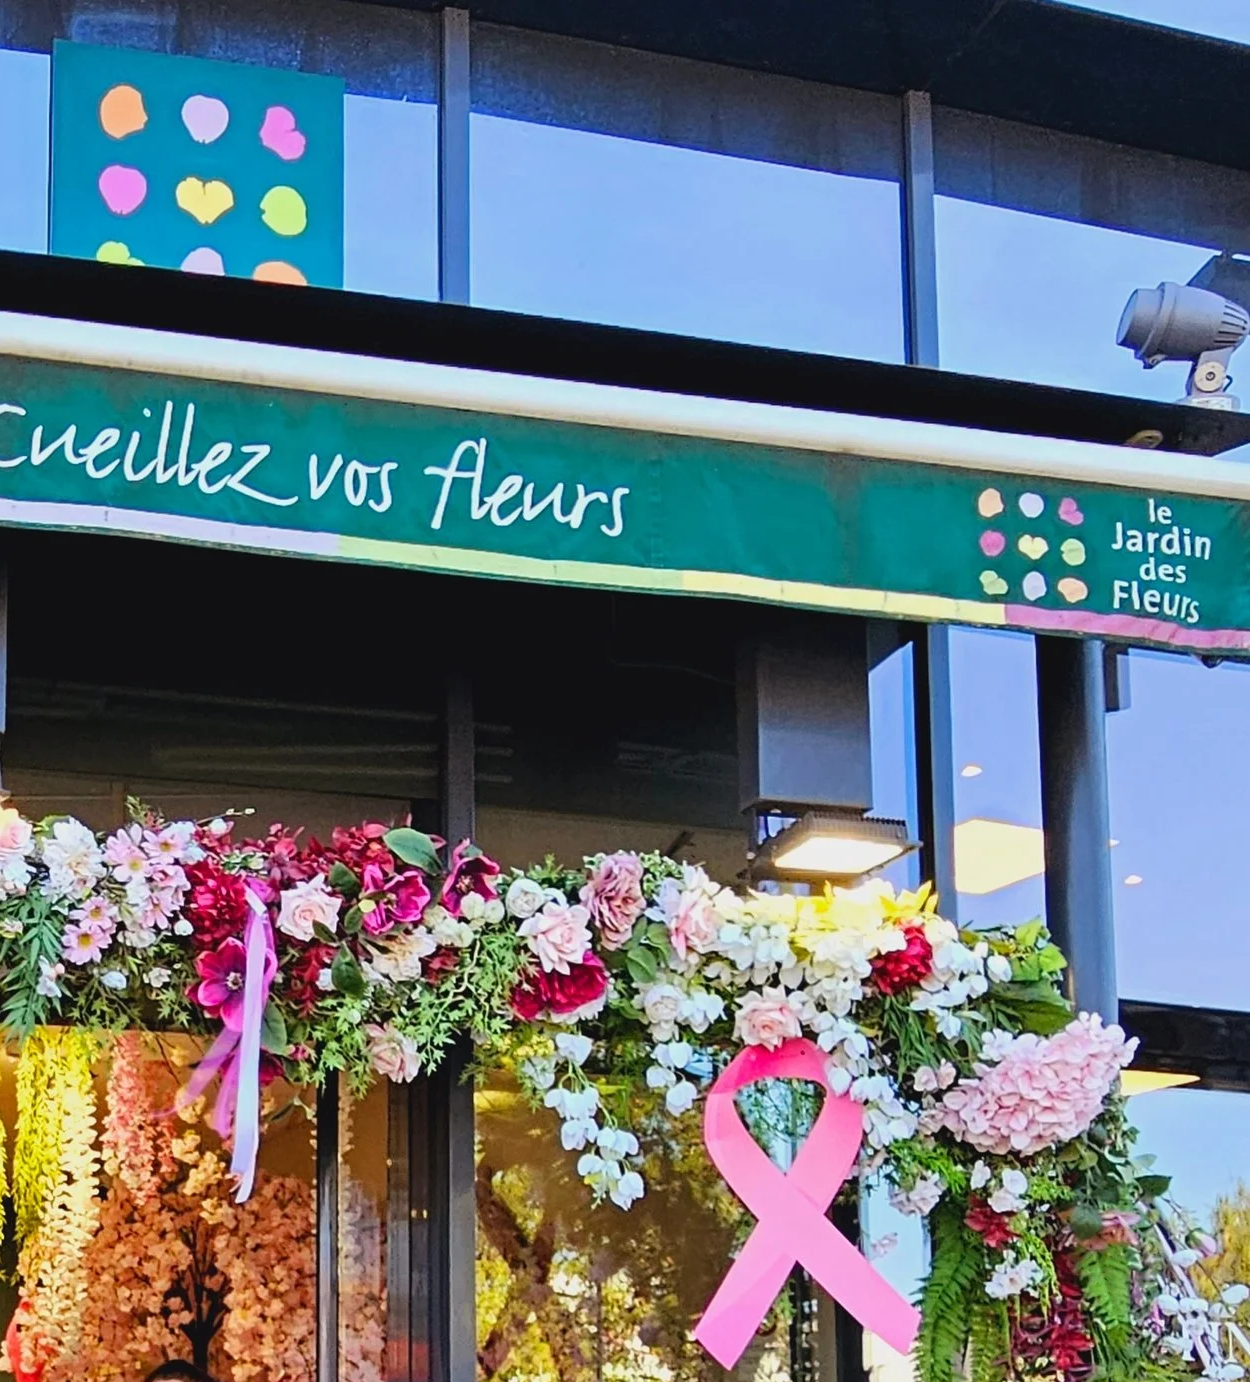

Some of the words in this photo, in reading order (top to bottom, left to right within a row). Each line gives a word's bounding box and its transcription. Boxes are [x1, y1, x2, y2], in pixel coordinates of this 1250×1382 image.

[308, 453, 399, 513] vos
[423, 438, 630, 538] fleurs
[1147, 498, 1172, 525] le
[1111, 522, 1212, 560] Jardin
[1139, 557, 1187, 584] des
[1113, 579, 1200, 624] Fleurs
